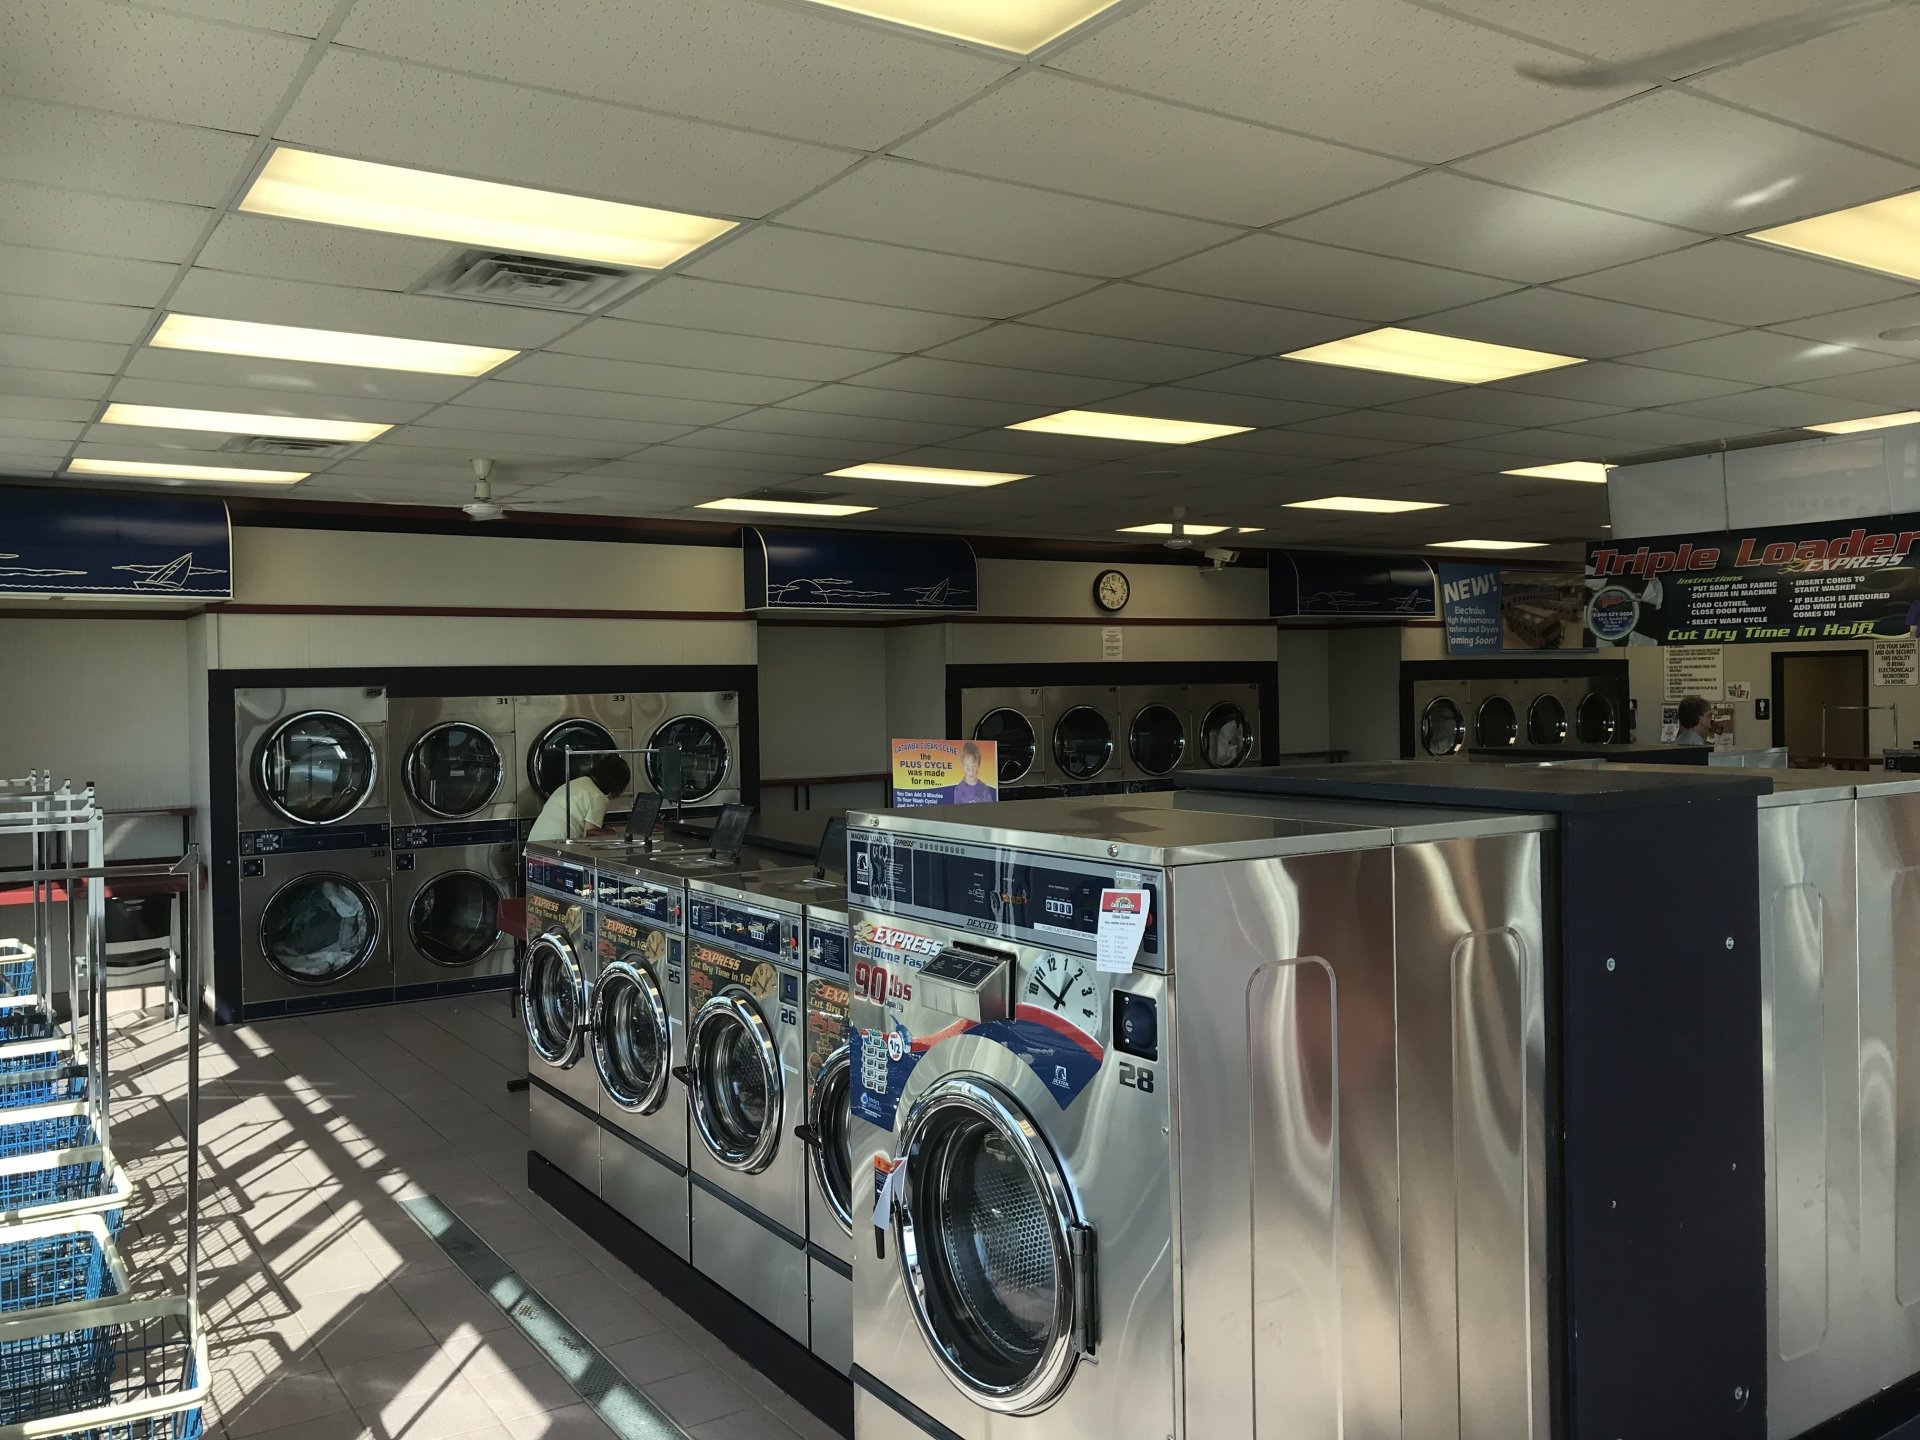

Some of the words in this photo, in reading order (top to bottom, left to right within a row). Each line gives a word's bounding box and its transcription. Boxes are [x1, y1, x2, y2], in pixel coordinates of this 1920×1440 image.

[1591, 543, 1720, 580] Triple
[1734, 528, 1920, 567] Loader
[1804, 553, 1907, 572] EXPRESS
[1677, 576, 1743, 584] Instructions
[1750, 581, 1778, 589] FABRIC
[1796, 578, 1825, 586] INSERT
[1444, 573, 1498, 604] NEW!
[1794, 586, 1820, 594] START
[1822, 584, 1856, 592] WASHER
[1849, 593, 1890, 601] REQUIRED
[1455, 606, 1486, 615] Electrolux
[1691, 608, 1714, 616] CLOSE
[1739, 606, 1767, 614] FIRMLY
[1460, 617, 1496, 625] Performance
[1667, 629, 1699, 641] Cut
[1704, 628, 1738, 642] Dry
[1745, 626, 1791, 639] Time
[1796, 625, 1817, 637] in
[1822, 622, 1875, 636] Half!
[1450, 636, 1474, 647] oming
[1475, 636, 1498, 645] Soon!
[613, 694, 625, 702] 33
[920, 742, 938, 750] CLEAN
[939, 744, 958, 756] SCENE
[925, 761, 953, 770] CYCLE
[911, 777, 921, 785] for
[532, 897, 560, 912] EXPRESS
[608, 920, 638, 938] EXPRESS
[967, 918, 998, 932] DEXTER
[583, 939, 593, 952] 24
[618, 934, 630, 946] Time
[630, 940, 636, 948] in
[874, 927, 944, 957] EXPRESS
[854, 942, 871, 957] Get
[874, 947, 900, 964] Done
[702, 951, 741, 970] EXPRESS
[1047, 957, 1057, 972] 12
[1064, 958, 1068, 971] 1
[668, 969, 680, 984] 25
[691, 959, 701, 969] Cut
[702, 962, 714, 975] Dry
[715, 967, 730, 979] Time
[732, 972, 739, 982] in
[1036, 966, 1046, 980] 11
[1073, 968, 1084, 981] 2
[854, 962, 888, 1007] 90
[889, 974, 912, 1002] lbs
[1029, 982, 1040, 996] 10
[1082, 987, 1093, 997] 3
[810, 997, 825, 1010] Cut
[826, 1001, 841, 1015] Dry
[1082, 1008, 1094, 1018] 4
[781, 1008, 796, 1026] 26
[890, 1040, 900, 1054] 1/2
[1120, 1061, 1154, 1094] 28
